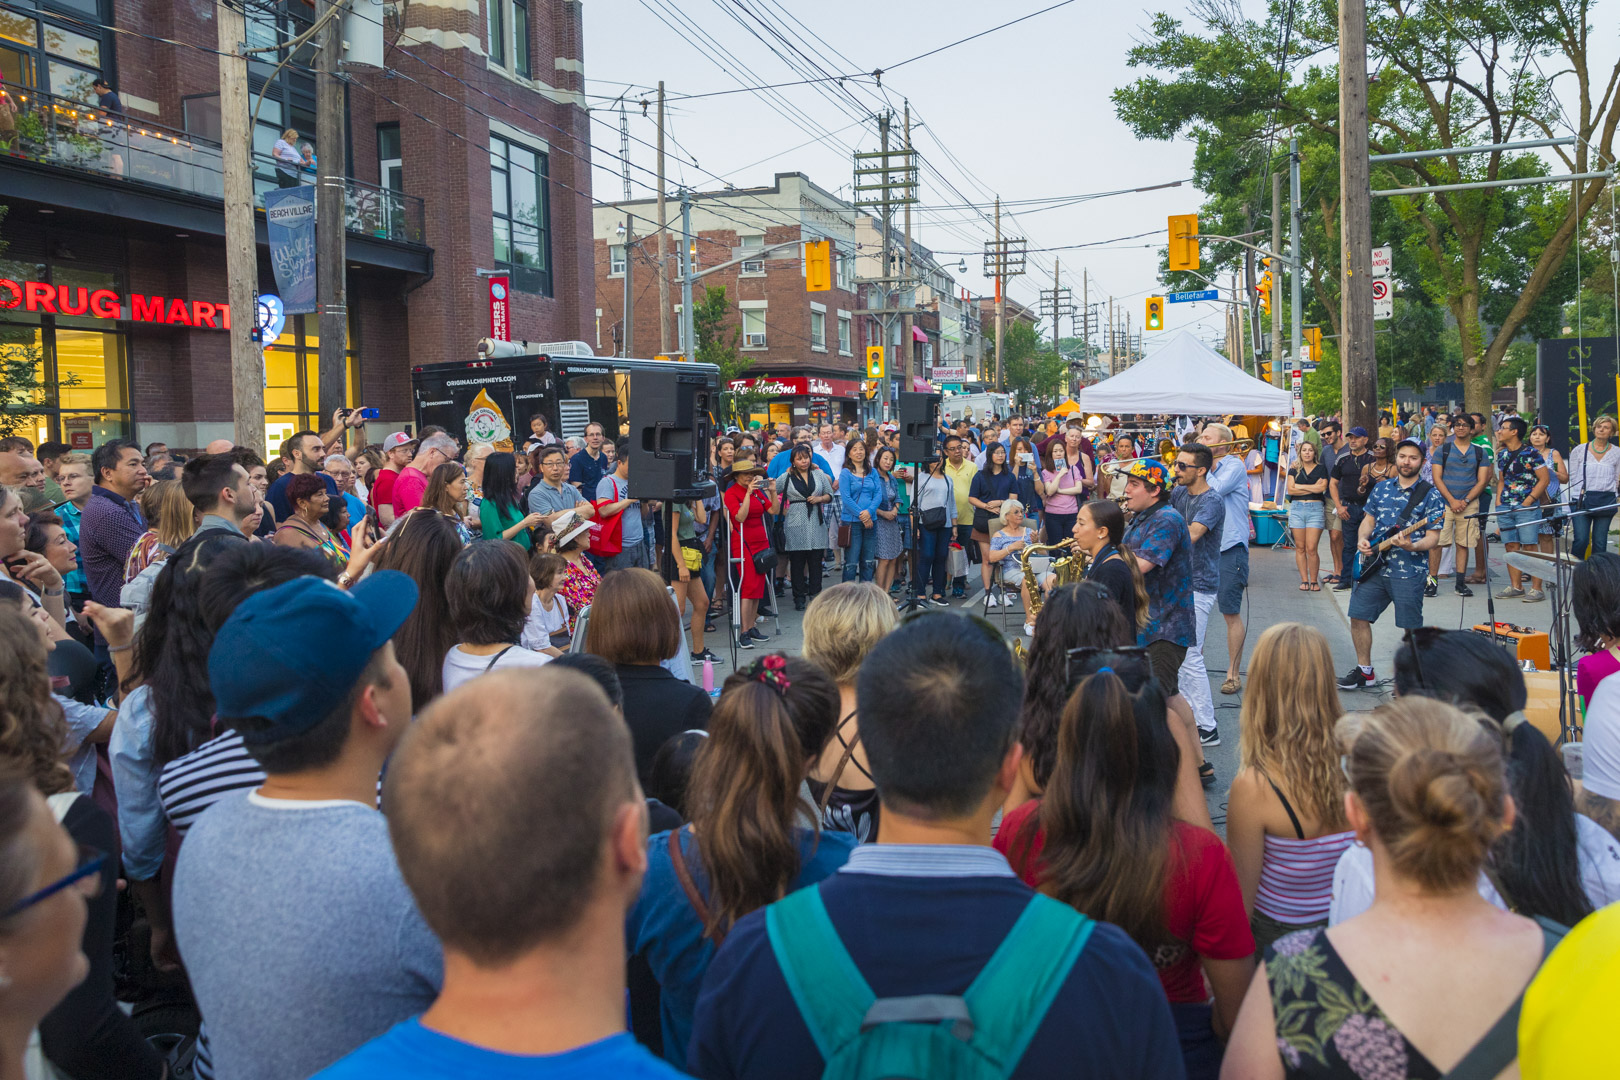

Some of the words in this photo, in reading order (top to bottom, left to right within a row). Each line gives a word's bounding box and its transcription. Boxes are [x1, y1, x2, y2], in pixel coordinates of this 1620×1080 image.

[270, 208, 290, 219] BEACH
[1372, 258, 1390, 268] ANDING
[1175, 292, 1205, 301] Bellefair
[0, 278, 121, 320] DRUG
[131, 293, 231, 330] MART
[446, 375, 517, 387] ORIGINALCHIMNEYS.COM
